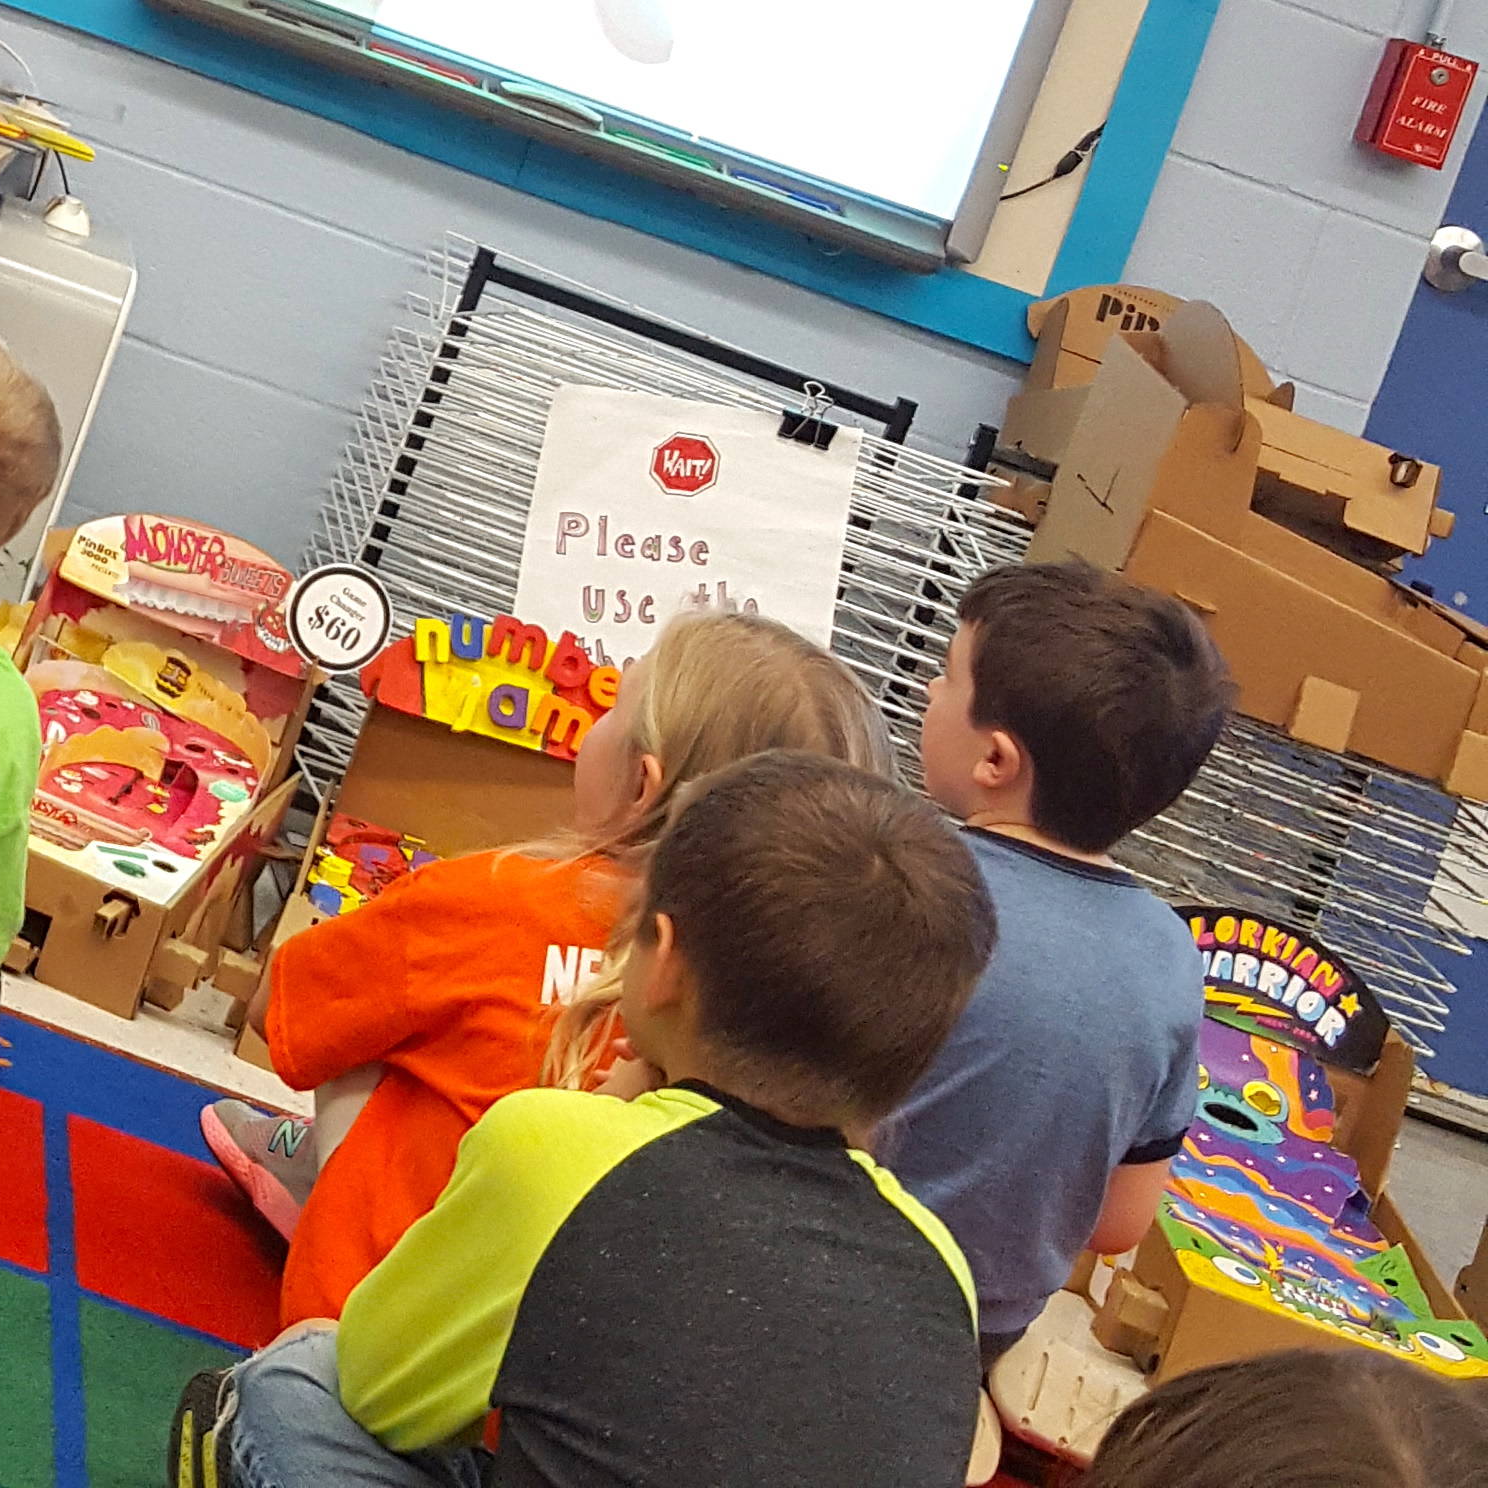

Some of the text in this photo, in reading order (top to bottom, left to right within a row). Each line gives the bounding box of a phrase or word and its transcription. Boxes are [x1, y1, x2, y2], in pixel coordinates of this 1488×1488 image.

[1431, 52, 1458, 69] PULL
[1412, 95, 1448, 116] FIRE
[1396, 114, 1448, 138] ALARM
[663, 447, 713, 478] WAIT!
[123, 516, 226, 580] MONSTER
[555, 512, 711, 566] Please
[330, 594, 366, 622] Changer
[342, 587, 367, 607] Game
[582, 584, 656, 624] use
[308, 604, 361, 651] $60
[1190, 915, 1345, 998] LORKIAN
